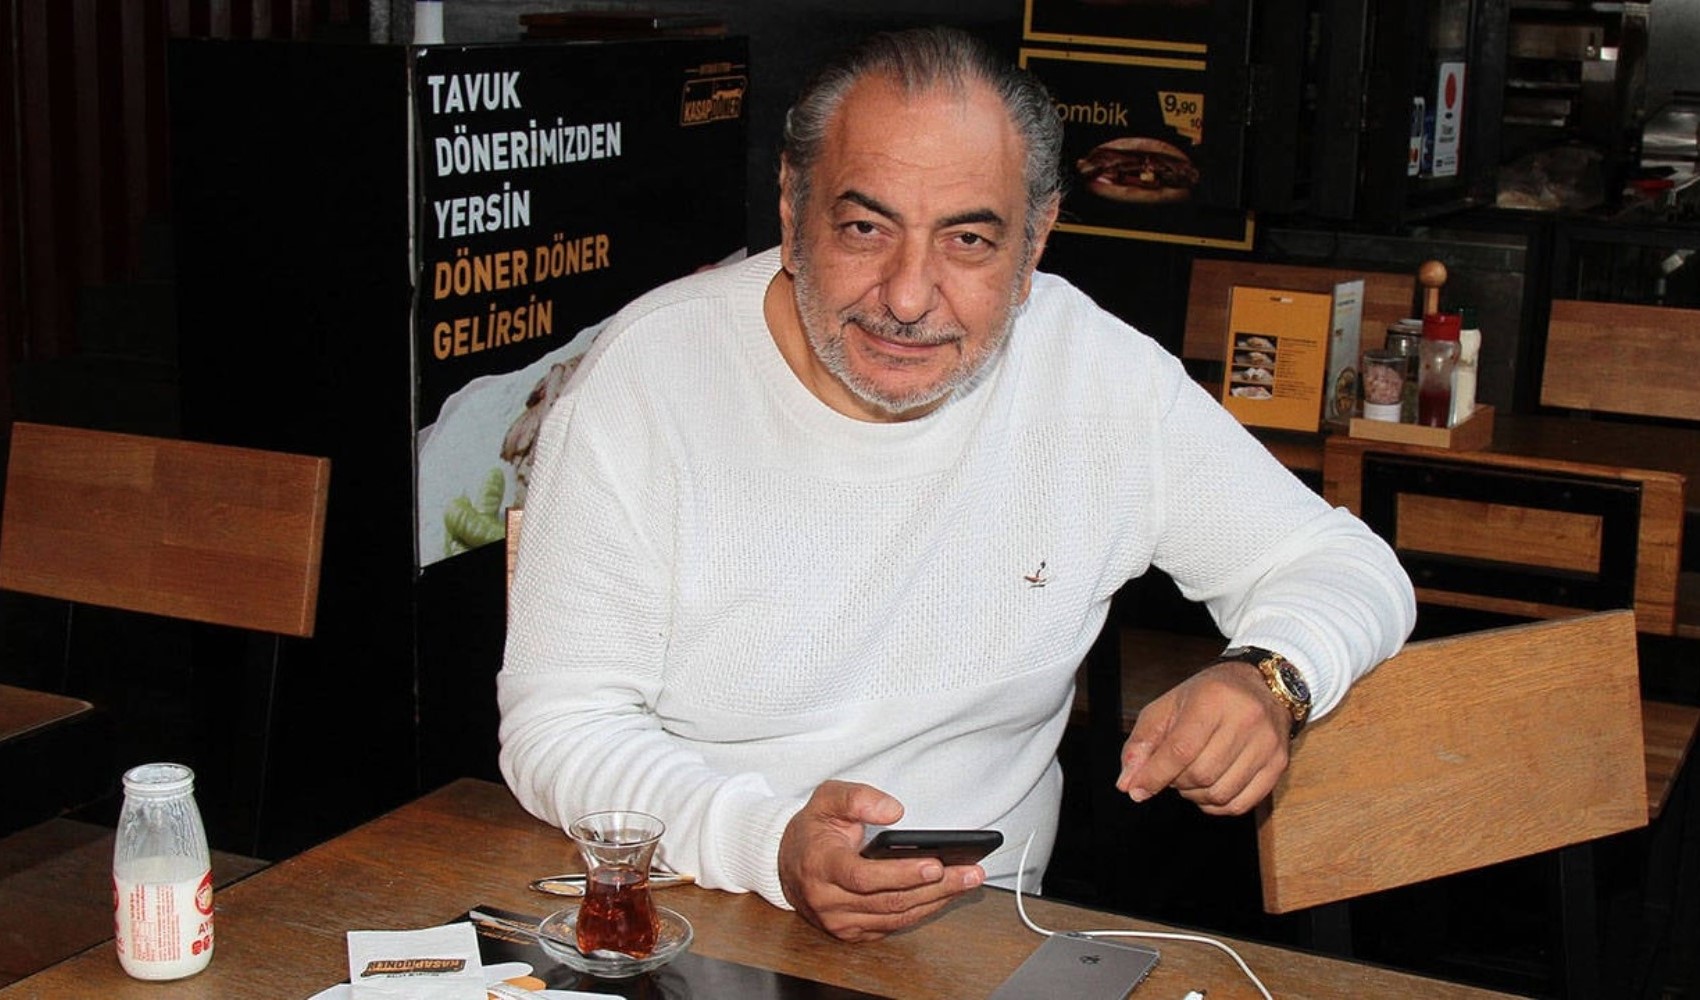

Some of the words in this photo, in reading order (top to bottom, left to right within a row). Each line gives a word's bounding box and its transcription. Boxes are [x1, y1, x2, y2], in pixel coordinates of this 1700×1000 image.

[427, 71, 521, 114] TAVUK
[1051, 97, 1128, 127] ombik
[1164, 94, 1196, 116] 9,90
[435, 117, 622, 177] DÖNERİMİZDEN
[434, 182, 531, 239] YERSİN
[434, 247, 528, 300] DÖNER
[535, 232, 610, 283] DÖNER
[433, 295, 552, 360] GELİRSİN
